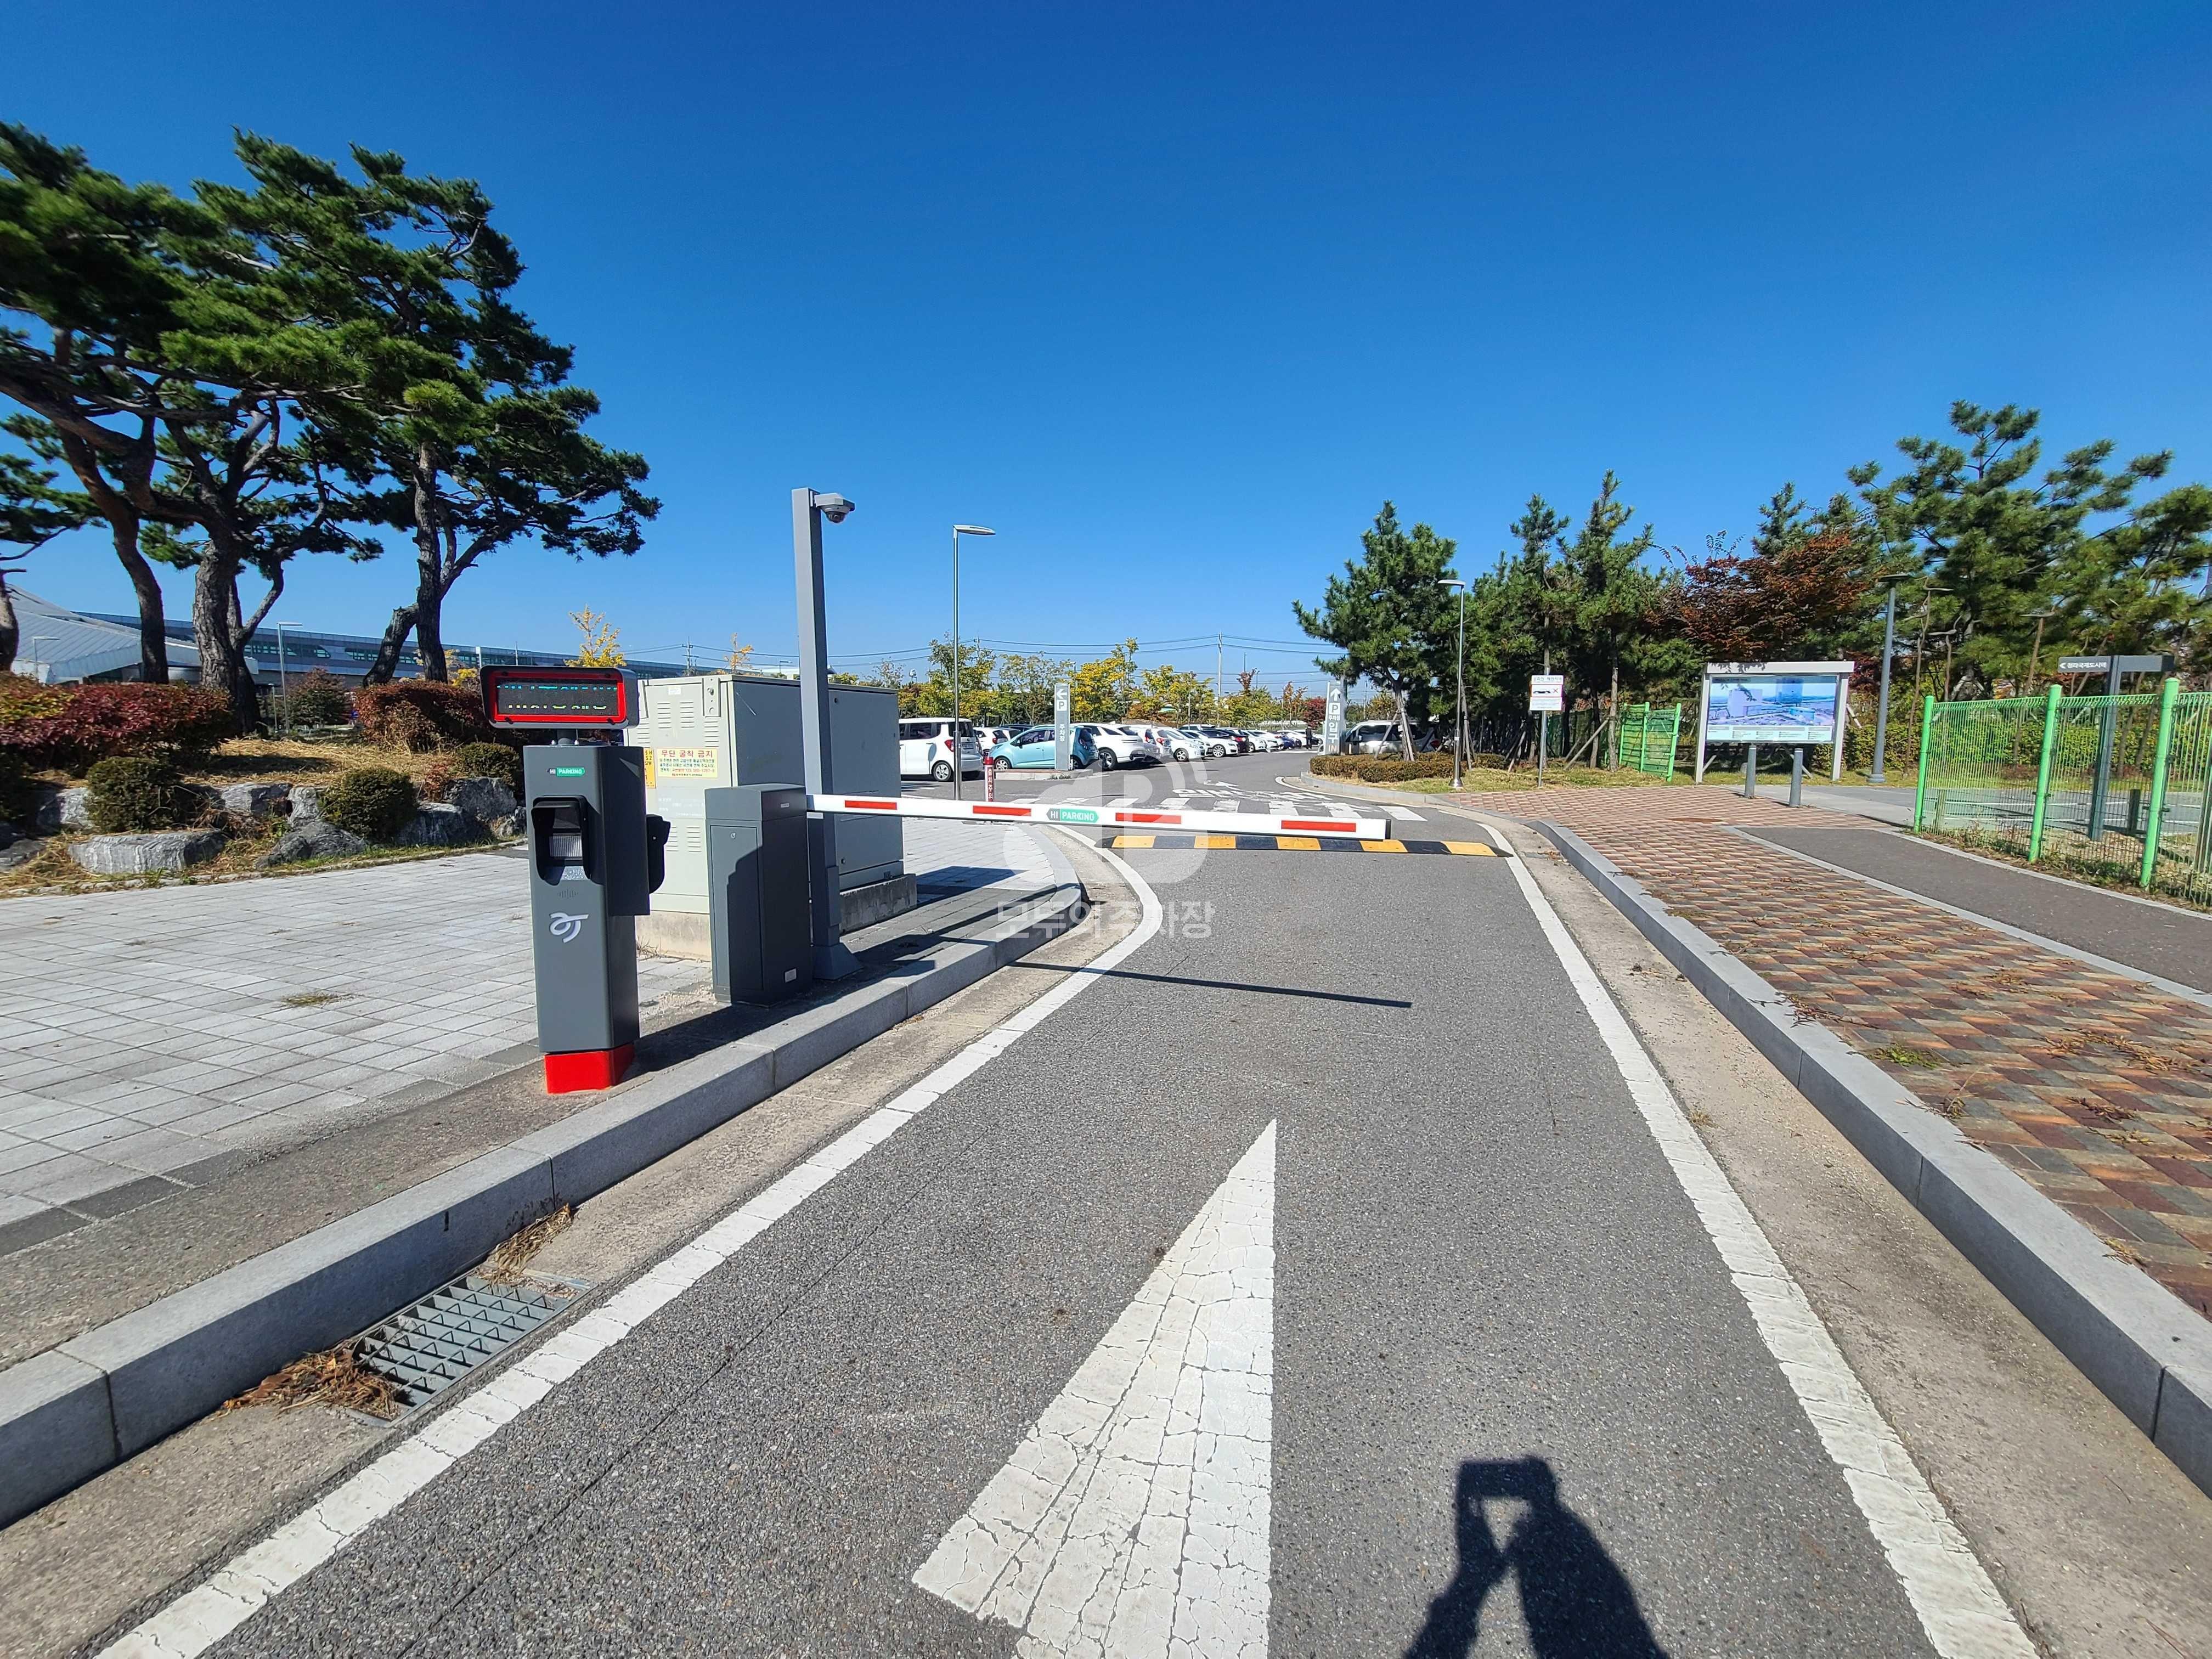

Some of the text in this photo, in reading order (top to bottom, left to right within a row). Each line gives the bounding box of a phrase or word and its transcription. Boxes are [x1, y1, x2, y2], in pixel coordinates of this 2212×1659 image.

[1328, 721, 1339, 744] 입구
[1328, 744, 1338, 753] IN
[1051, 811, 1095, 821] HI PARKING
